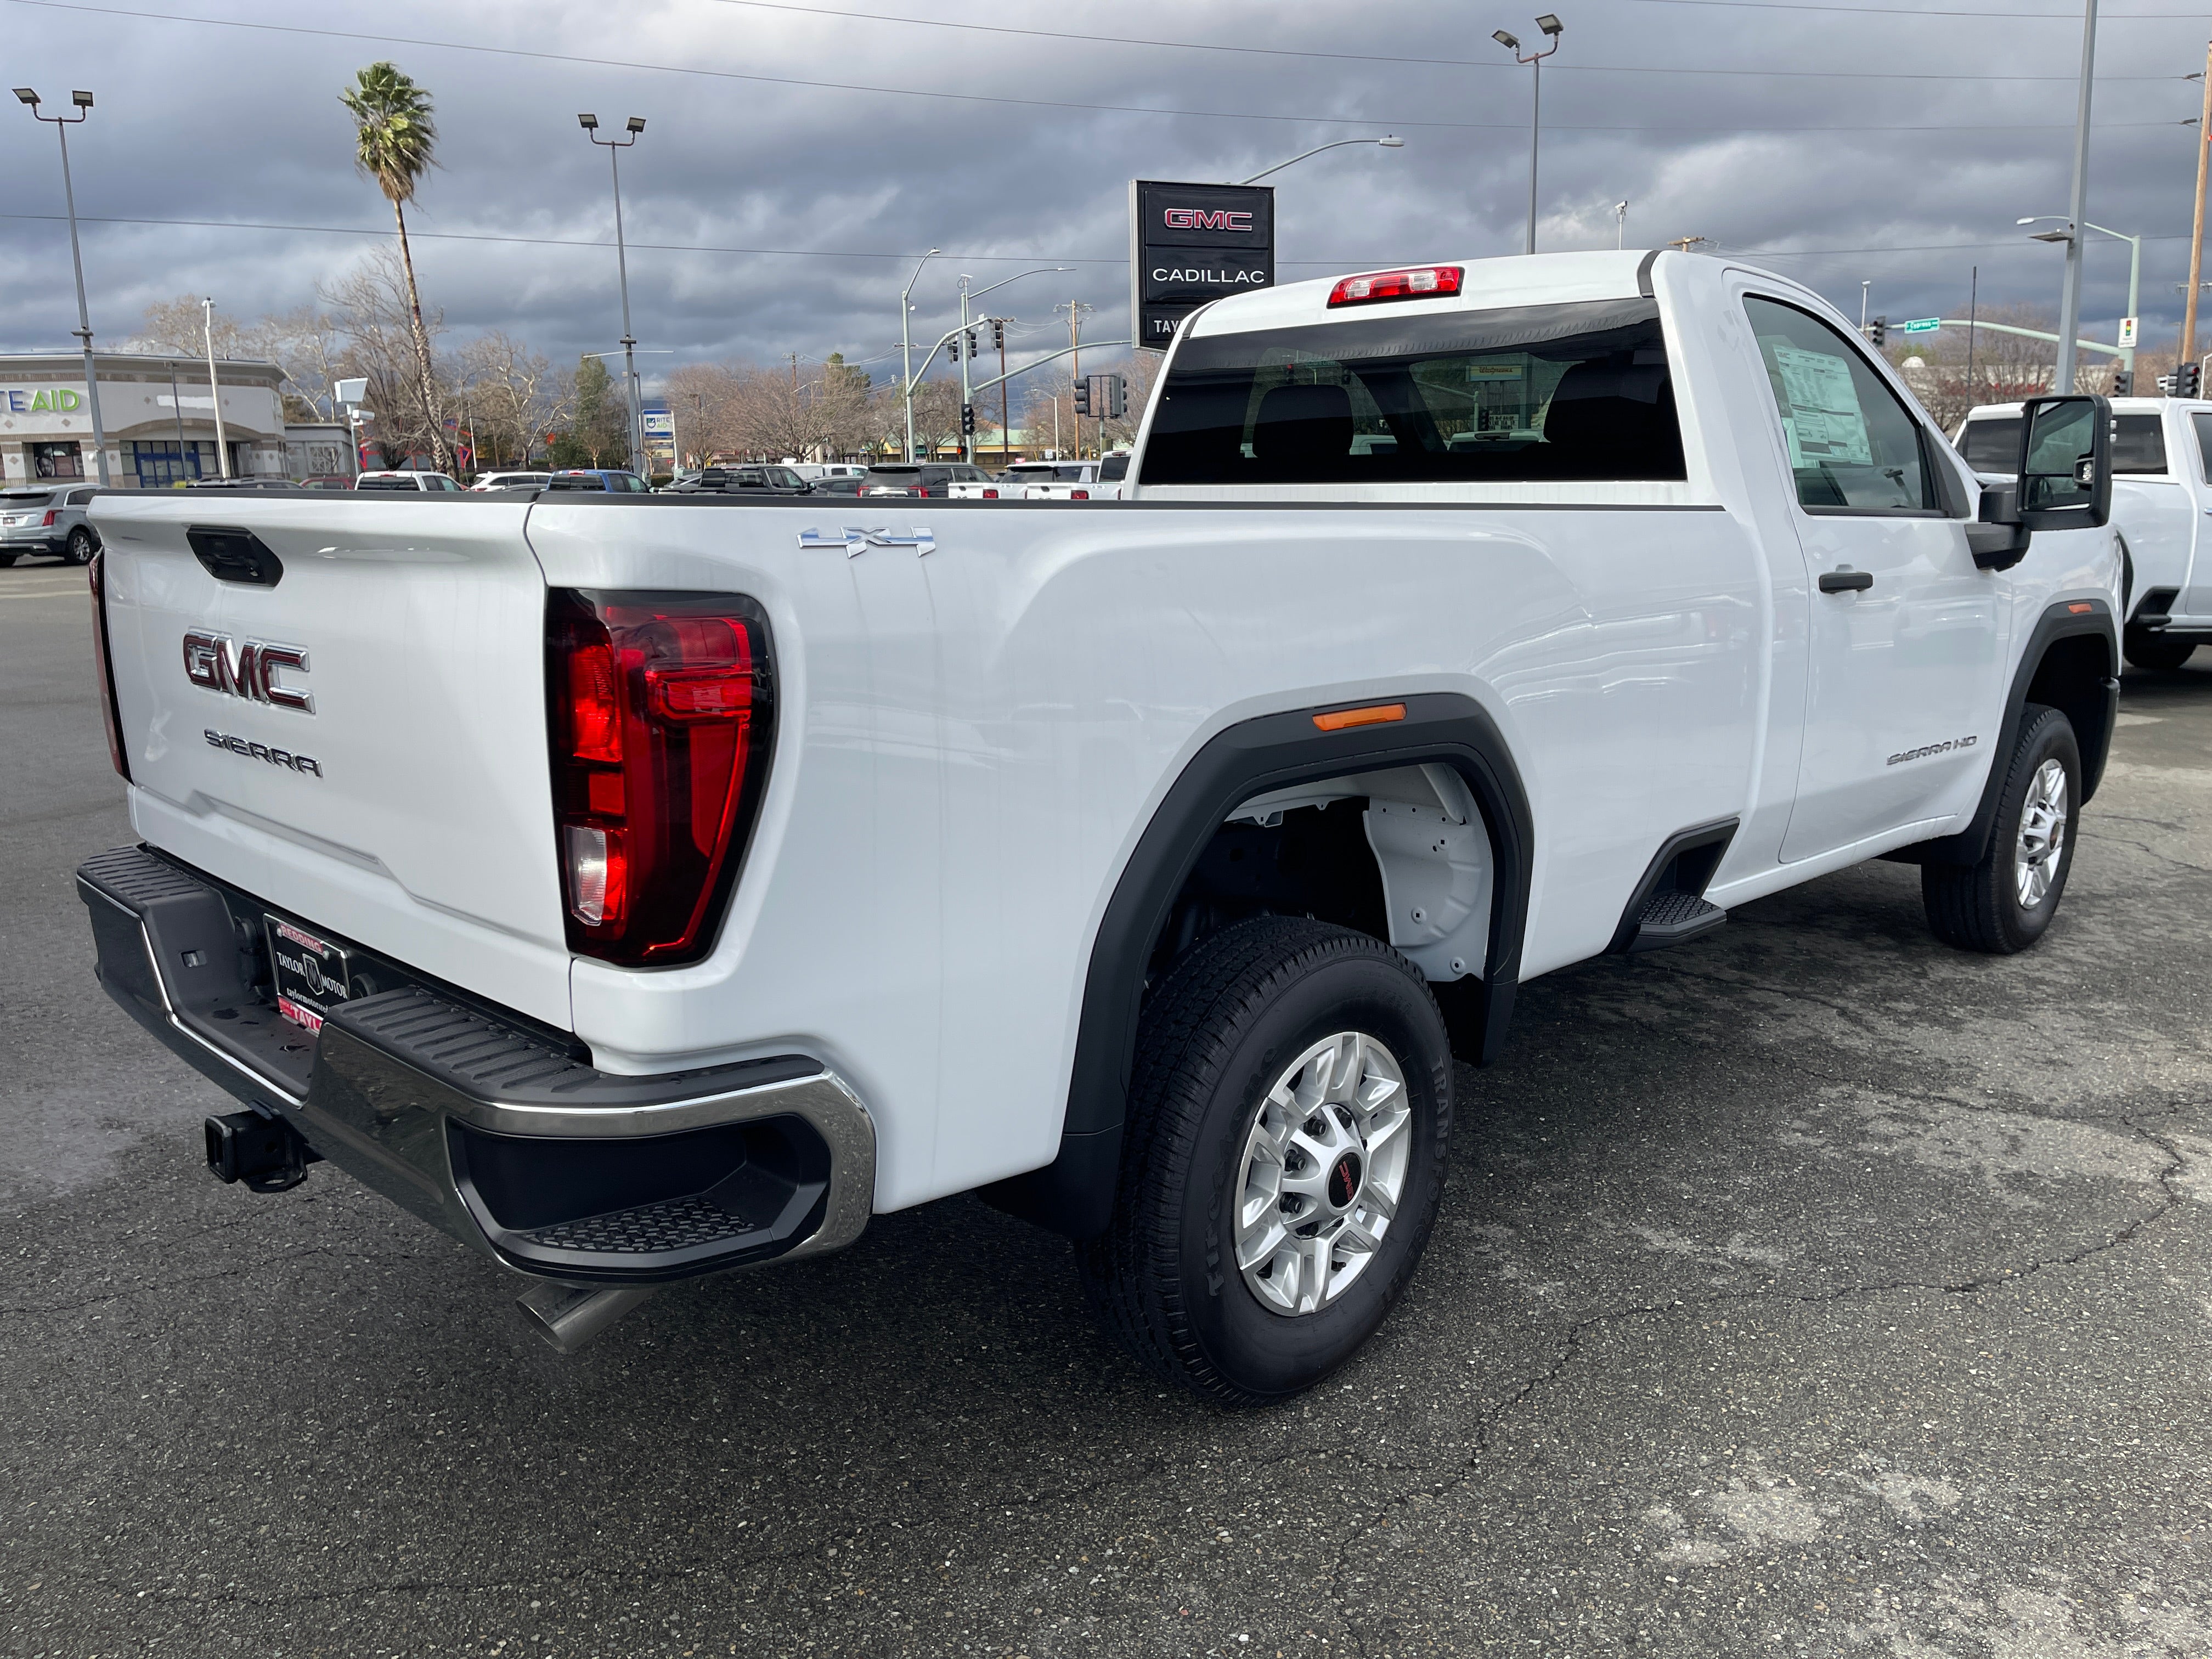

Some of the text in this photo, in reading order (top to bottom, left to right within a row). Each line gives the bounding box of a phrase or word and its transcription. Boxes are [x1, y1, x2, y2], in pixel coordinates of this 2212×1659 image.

[1165, 208, 1252, 232] GMC
[1153, 268, 1265, 283] CADILLAC
[1154, 319, 1181, 333] TAY
[1479, 366, 1513, 375] Walgreens
[31, 389, 80, 411] AID
[183, 630, 317, 715] GMC
[204, 728, 324, 778] SIERRA
[1886, 736, 1978, 765] SIERRA HD
[280, 924, 323, 953] REDDING
[276, 951, 306, 978] TAYLOR
[321, 973, 348, 1000] MOTOR
[286, 988, 329, 1014] taylormotorsred
[1404, 1056, 1449, 1261] TRANSFORCE
[1339, 1160, 1355, 1201] GMC
